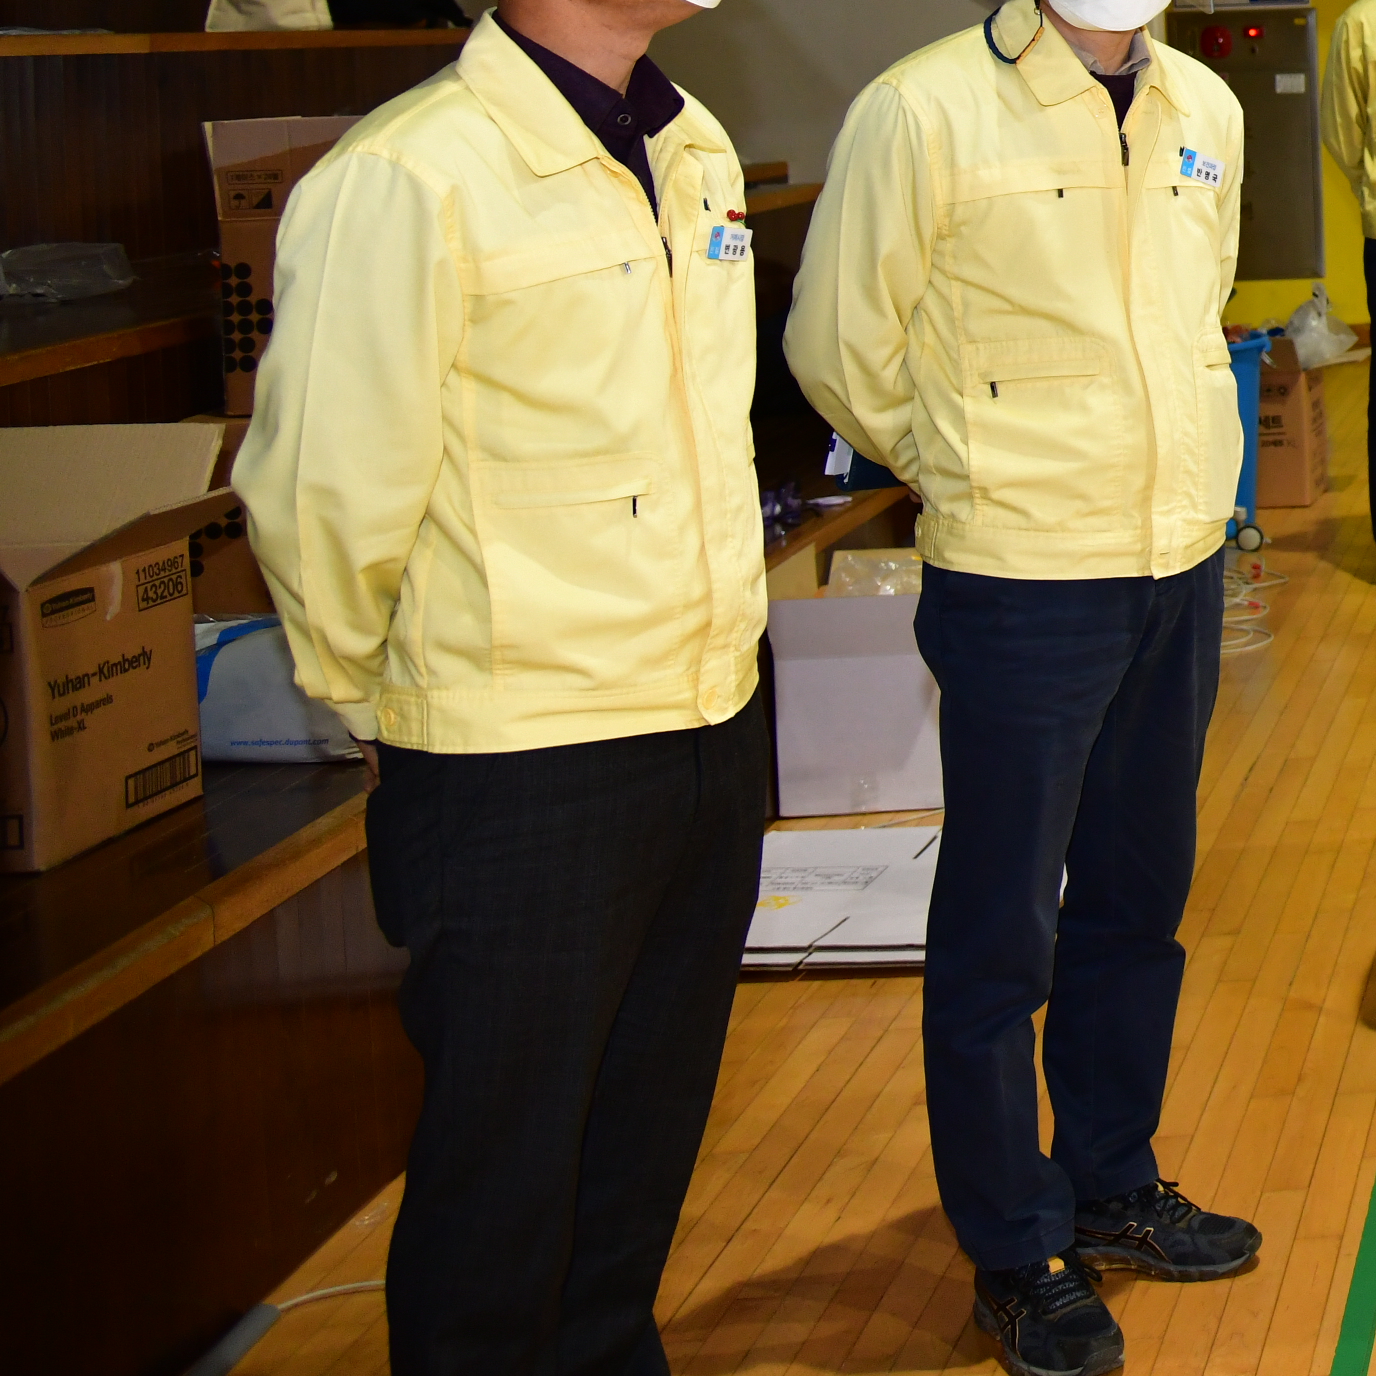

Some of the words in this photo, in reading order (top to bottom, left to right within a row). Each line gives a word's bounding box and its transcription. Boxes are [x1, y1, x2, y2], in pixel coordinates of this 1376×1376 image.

[135, 554, 185, 582] 11034967
[141, 574, 184, 605] 43206
[48, 646, 153, 700] Yuhan-Kimberly
[50, 708, 71, 726] Level
[72, 705, 79, 718] D
[80, 693, 114, 716] Apparels
[50, 718, 87, 742] White-XL
[230, 738, 329, 748] www.safespec.dupont.com
